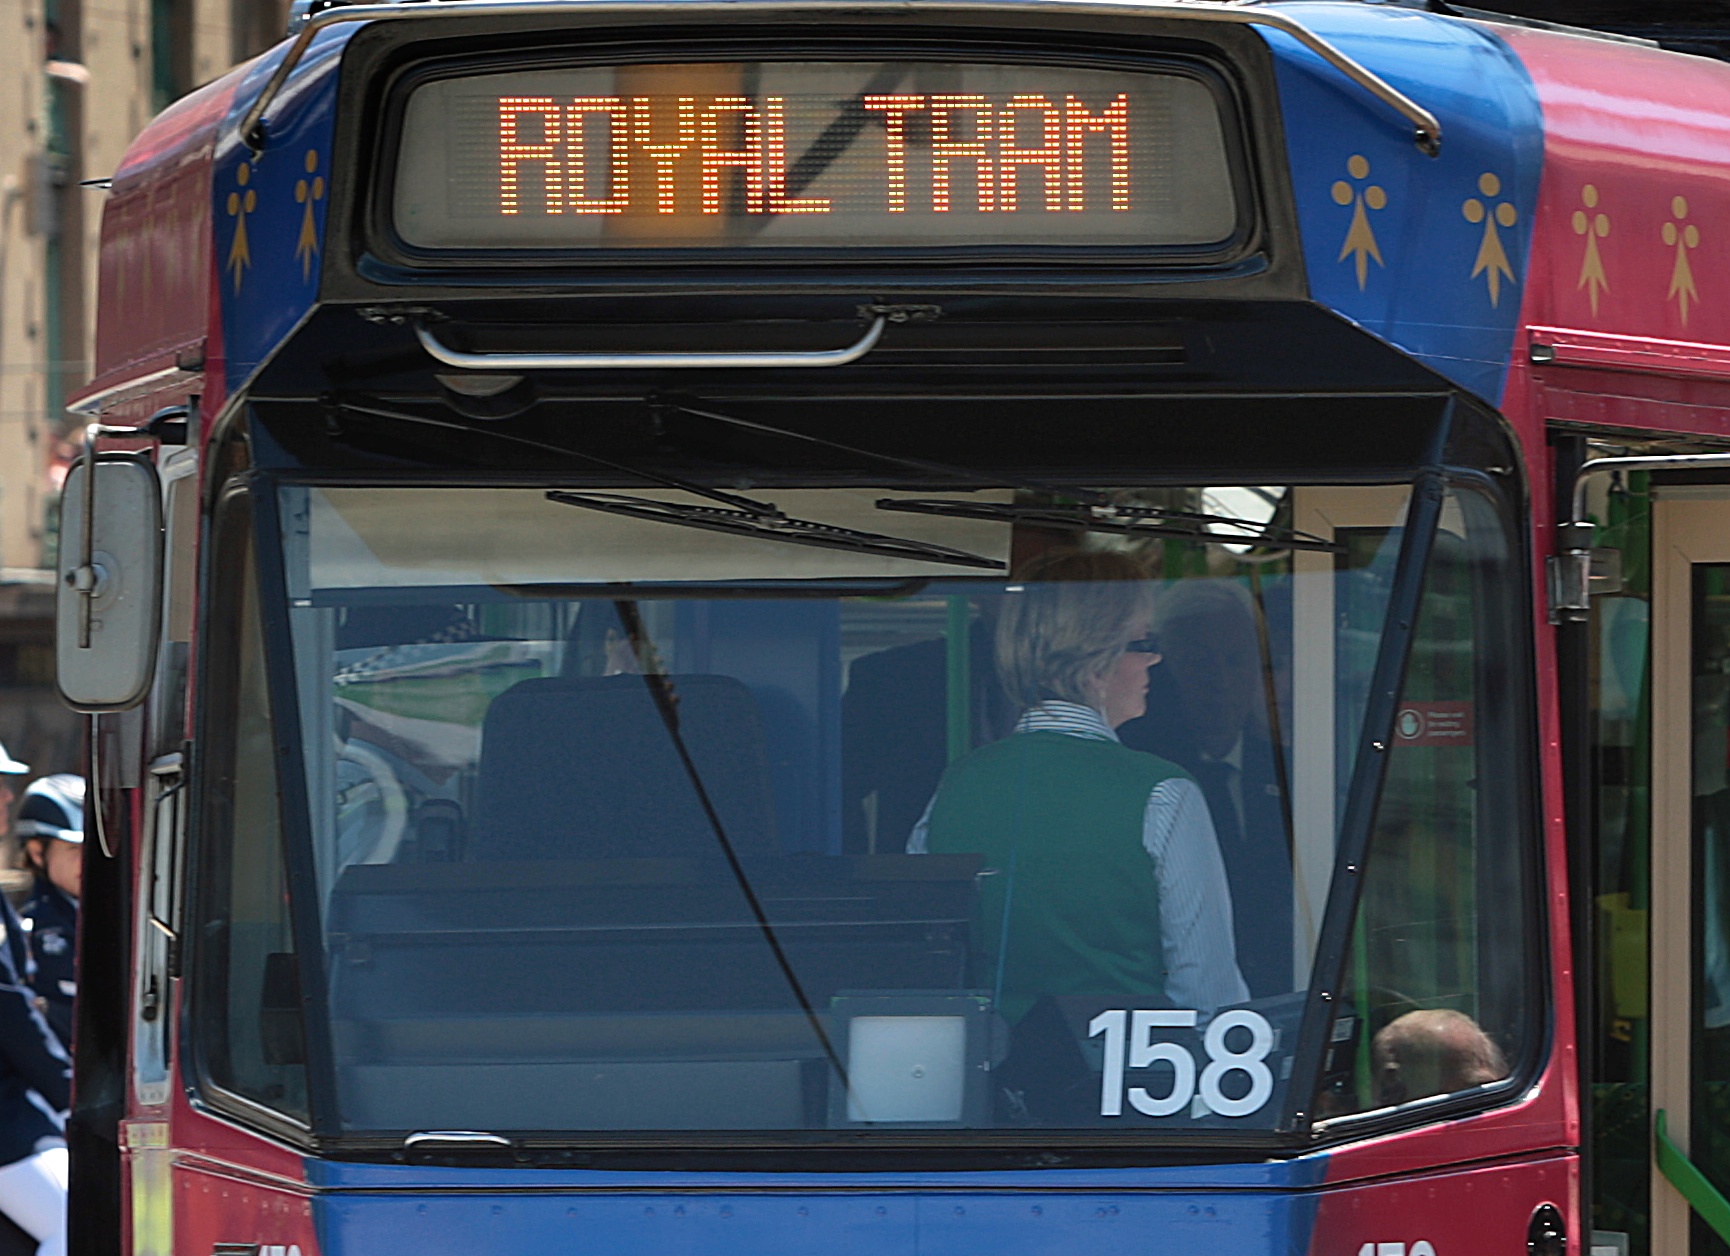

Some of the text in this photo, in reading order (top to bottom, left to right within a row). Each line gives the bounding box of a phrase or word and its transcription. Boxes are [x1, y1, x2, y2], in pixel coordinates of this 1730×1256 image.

[497, 93, 1131, 215] ROYAL TRAM
[1088, 1009, 1275, 1118] 158
